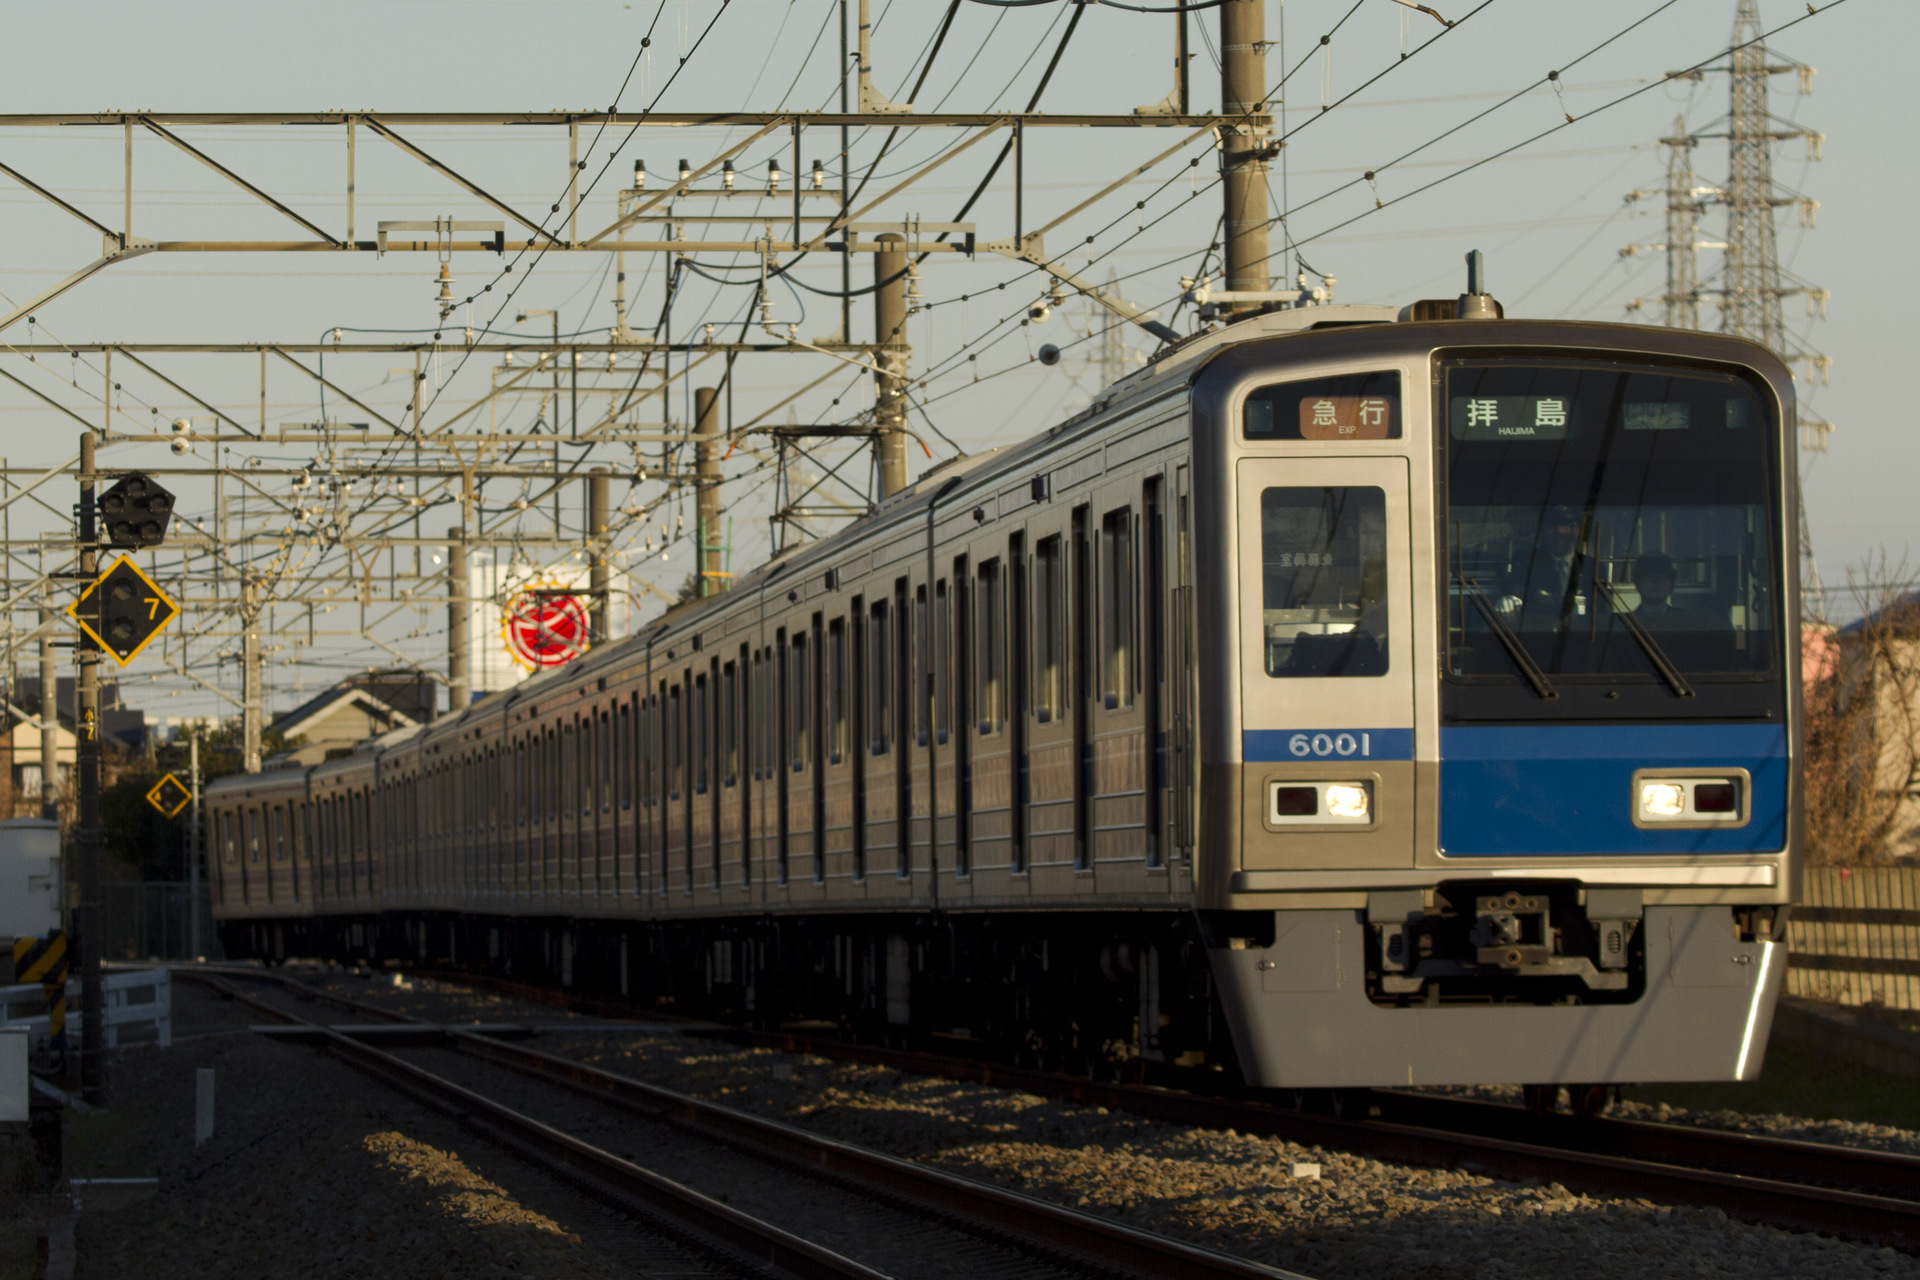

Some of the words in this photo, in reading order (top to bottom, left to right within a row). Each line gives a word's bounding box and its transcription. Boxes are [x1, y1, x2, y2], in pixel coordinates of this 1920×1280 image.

[1312, 399, 1385, 426] 急行
[1467, 399, 1567, 427] 拝島
[1498, 427, 1535, 436] HAIJIMA
[143, 598, 160, 621] 7
[1288, 732, 1370, 757] 6001
